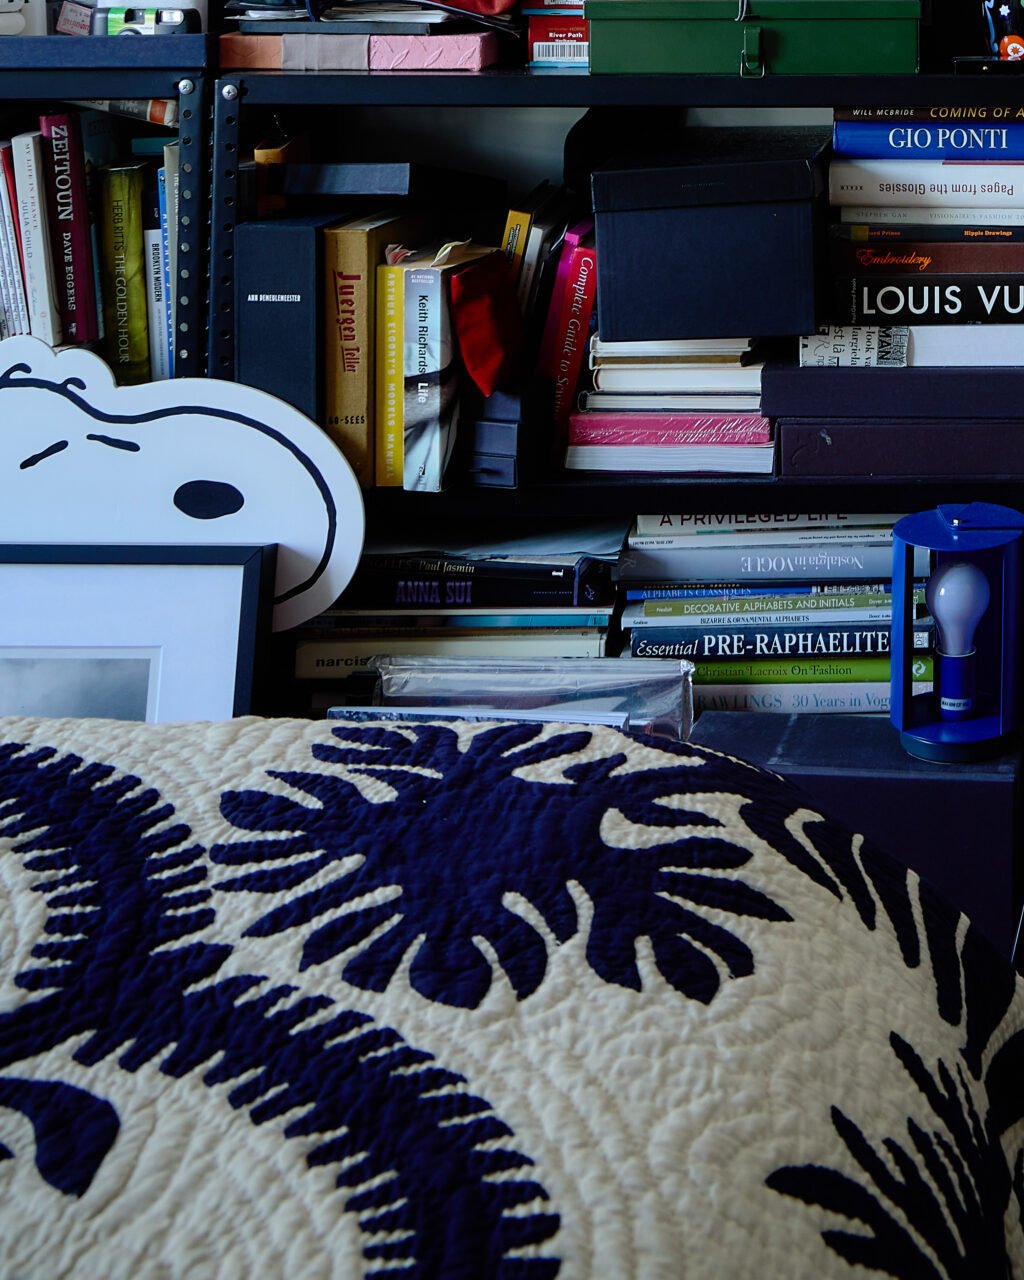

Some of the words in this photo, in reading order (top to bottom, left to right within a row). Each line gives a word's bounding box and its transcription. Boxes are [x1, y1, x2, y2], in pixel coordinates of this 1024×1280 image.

[929, 107, 987, 118] COMING
[992, 107, 1011, 118] OF
[888, 128, 932, 149] GIO
[936, 128, 1008, 149] PONTI
[51, 124, 74, 221] ZEITOUN
[879, 183, 926, 195] Glossies
[929, 183, 949, 195] the
[952, 183, 977, 195] from
[980, 182, 1014, 196] Pages
[21, 200, 30, 228] JULIA
[30, 194, 38, 229] FRANCE
[112, 200, 124, 226] HERB
[25, 231, 33, 259] CHILD
[113, 227, 125, 251] RITTS
[964, 230, 983, 238] Hippie
[62, 232, 73, 263] DAVE
[152, 243, 160, 274] BROOKLYN
[855, 248, 934, 271] Embroidery
[114, 252, 126, 275] THE
[65, 266, 77, 312] EGGERS
[153, 276, 162, 303] MODERN
[387, 272, 395, 316] ARTHUR
[569, 256, 593, 313] Complete
[115, 276, 128, 323] GOLDEN
[336, 272, 362, 341] Juergen
[418, 294, 429, 322] Keith
[863, 284, 963, 315] LOUIS
[117, 325, 130, 362] HOUR
[563, 317, 581, 355] Guide
[344, 347, 361, 372] Teller
[387, 323, 396, 375] ELGORT'S
[418, 325, 429, 374] Richards
[559, 358, 570, 374] to
[387, 383, 396, 426] MODELS
[417, 382, 429, 403] Life
[386, 432, 395, 478] MANUAL
[419, 560, 440, 571] Paul
[442, 561, 476, 574] Jasmin
[741, 556, 794, 572] VOGUE
[793, 556, 807, 568] in
[809, 552, 864, 570] Nostalgia
[395, 580, 441, 604] ANNA
[445, 580, 473, 604] SUI
[641, 588, 694, 599] ALPHABETS
[696, 587, 752, 598] CLASSIQUES
[684, 602, 740, 614] DECORATIVE
[743, 601, 793, 612] ALPHABETS
[796, 600, 817, 610] AND
[819, 598, 855, 608] INITIALS
[726, 616, 732, 624] &
[732, 616, 772, 624] ORNAMENTAL
[774, 614, 810, 622] ALPHABETS
[636, 639, 699, 657] Essential
[703, 631, 891, 656] PRE-RAPHAELITE
[696, 665, 744, 677] Christian
[746, 664, 788, 676] Lacroix
[790, 664, 808, 676] On
[809, 664, 852, 676] Fashion
[792, 694, 809, 708] 30
[813, 694, 846, 708] Years
[849, 693, 862, 707] in
